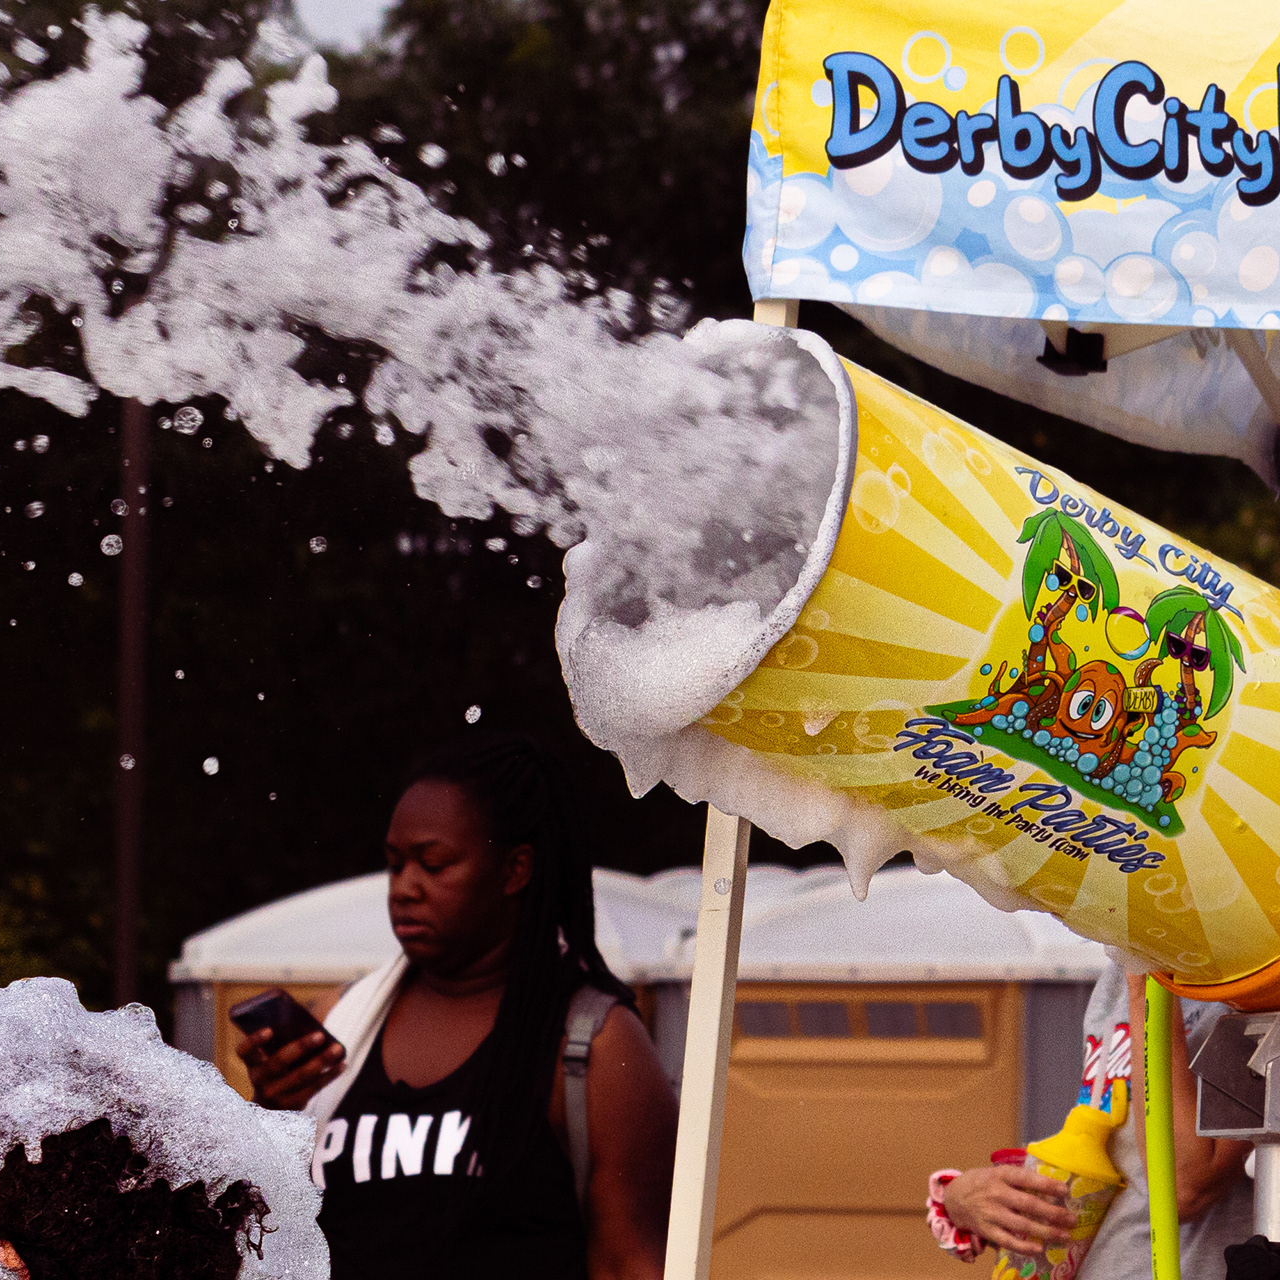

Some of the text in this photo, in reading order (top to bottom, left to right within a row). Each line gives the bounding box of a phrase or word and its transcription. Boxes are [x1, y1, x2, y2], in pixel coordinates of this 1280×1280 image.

[1014, 466, 1245, 624] Derby City
[893, 717, 1166, 873] Foam Parties
[310, 1110, 484, 1191] PINK
